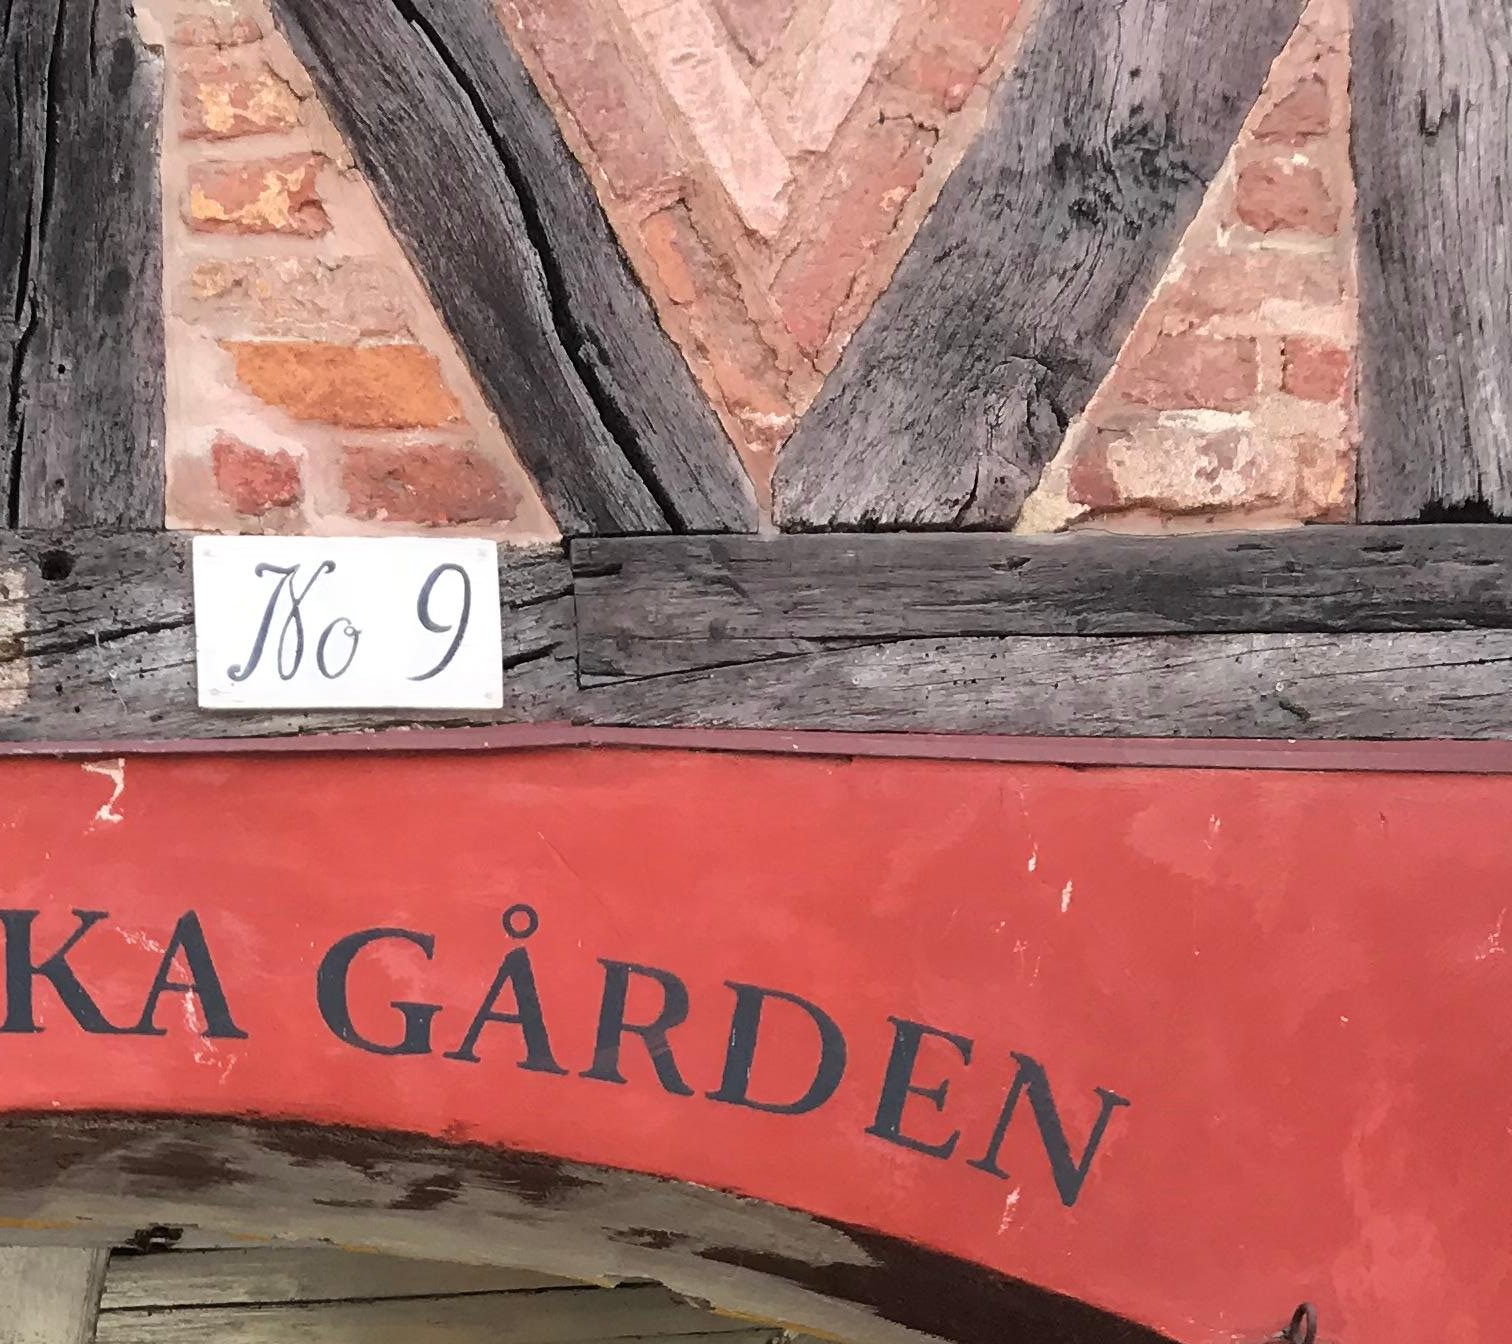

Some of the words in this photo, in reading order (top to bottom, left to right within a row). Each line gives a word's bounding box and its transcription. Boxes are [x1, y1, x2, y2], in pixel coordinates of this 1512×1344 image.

[226, 559, 363, 682] No
[405, 561, 472, 682] 9
[315, 903, 1131, 1208] GÅRDEN
